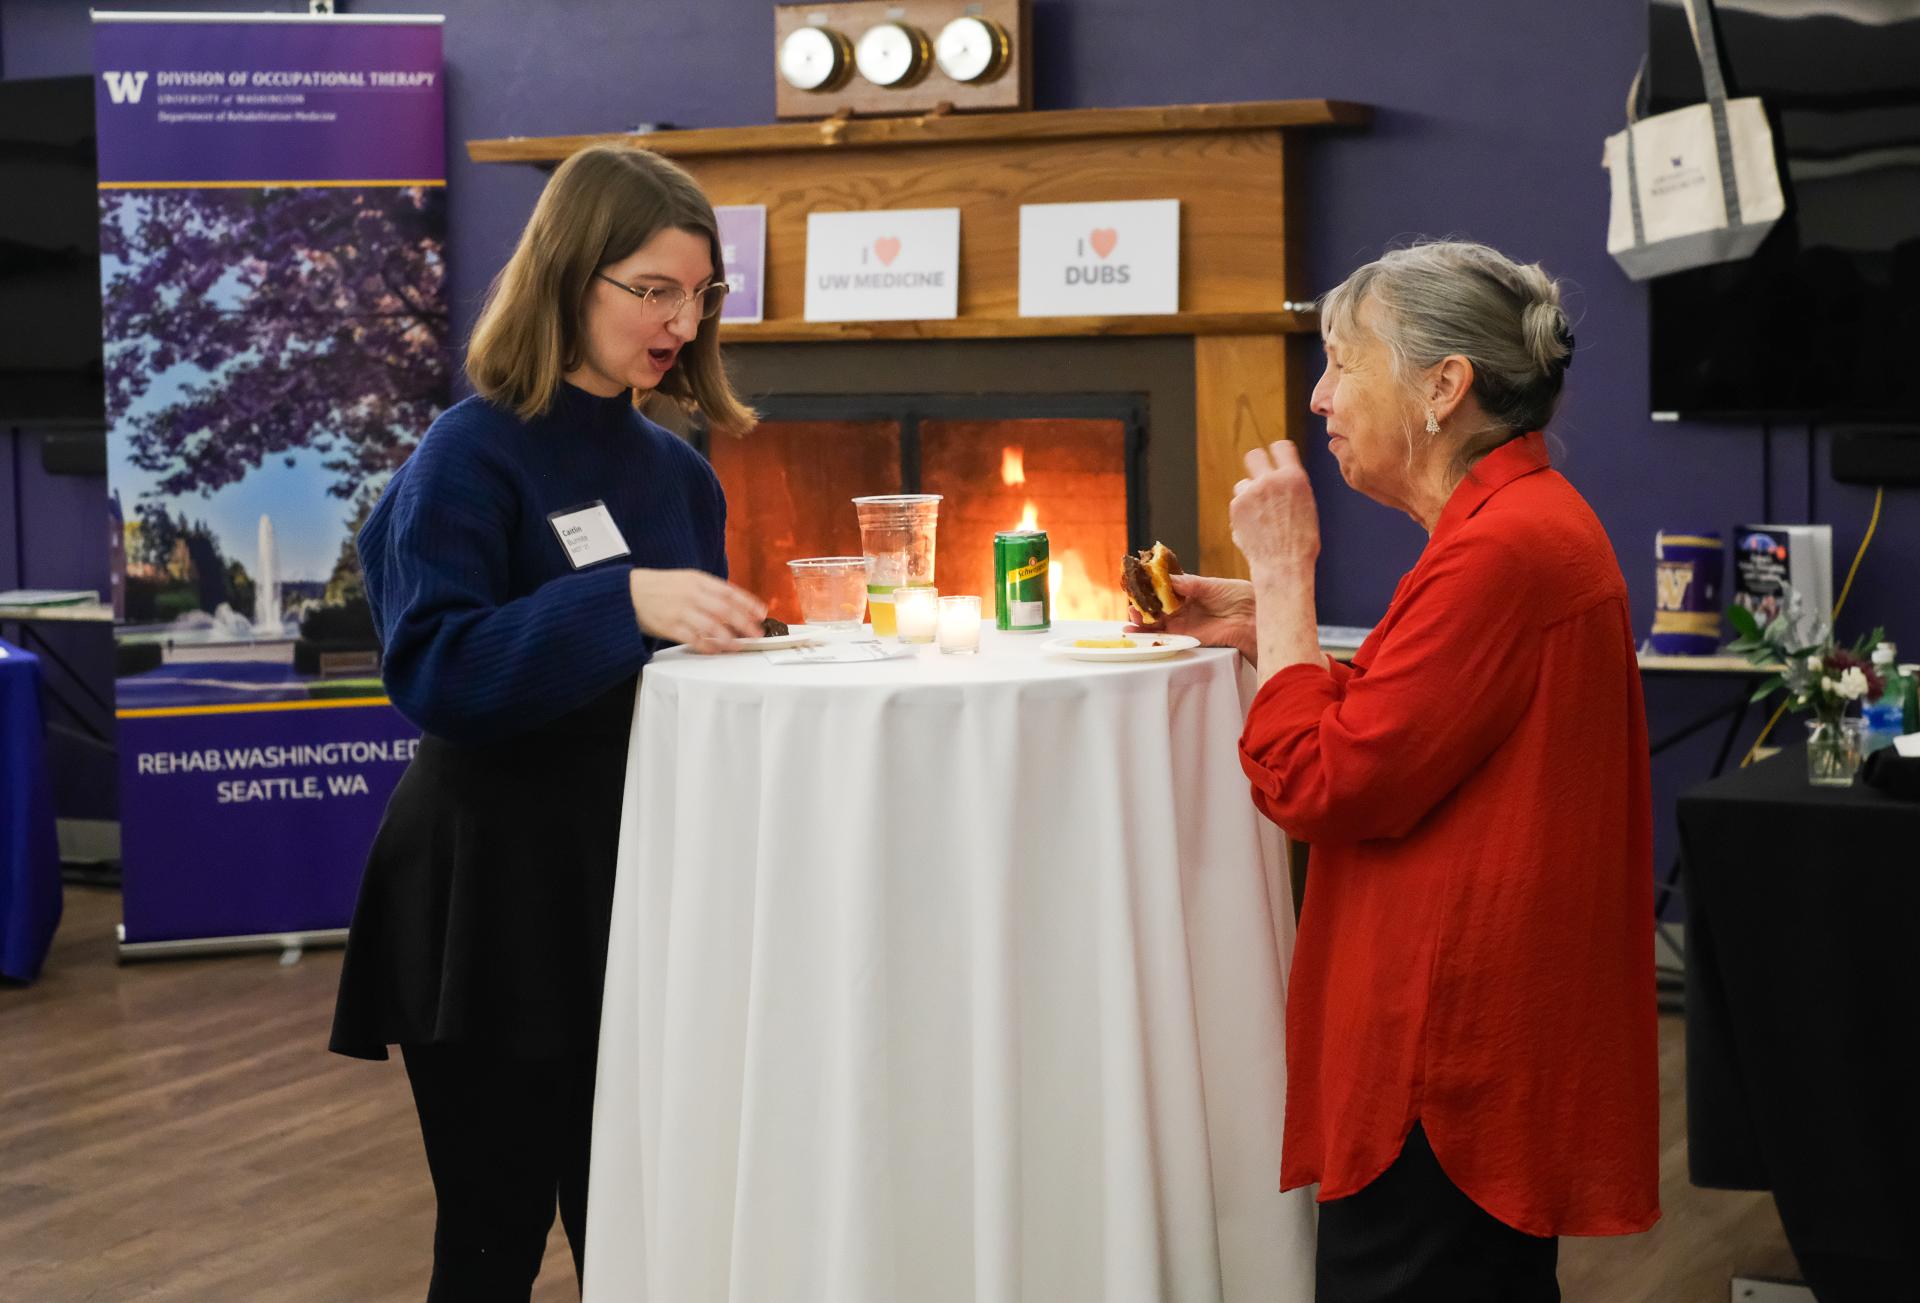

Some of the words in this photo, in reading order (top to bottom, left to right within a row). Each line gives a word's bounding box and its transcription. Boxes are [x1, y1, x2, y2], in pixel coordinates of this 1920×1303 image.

[103, 72, 148, 103] W
[157, 71, 225, 87] DIVISION
[228, 71, 248, 87] OF
[252, 71, 366, 87] OCCUPATIONAL
[370, 71, 435, 87] THERAPY
[157, 94, 219, 104] UNIVERSITY
[235, 94, 305, 104] WASHINGTON
[818, 273, 851, 291] UW
[853, 270, 945, 290] MEDICINE
[1065, 264, 1131, 285] DUBS
[217, 777, 324, 804] SEATTLE,
[328, 774, 369, 796] WA
